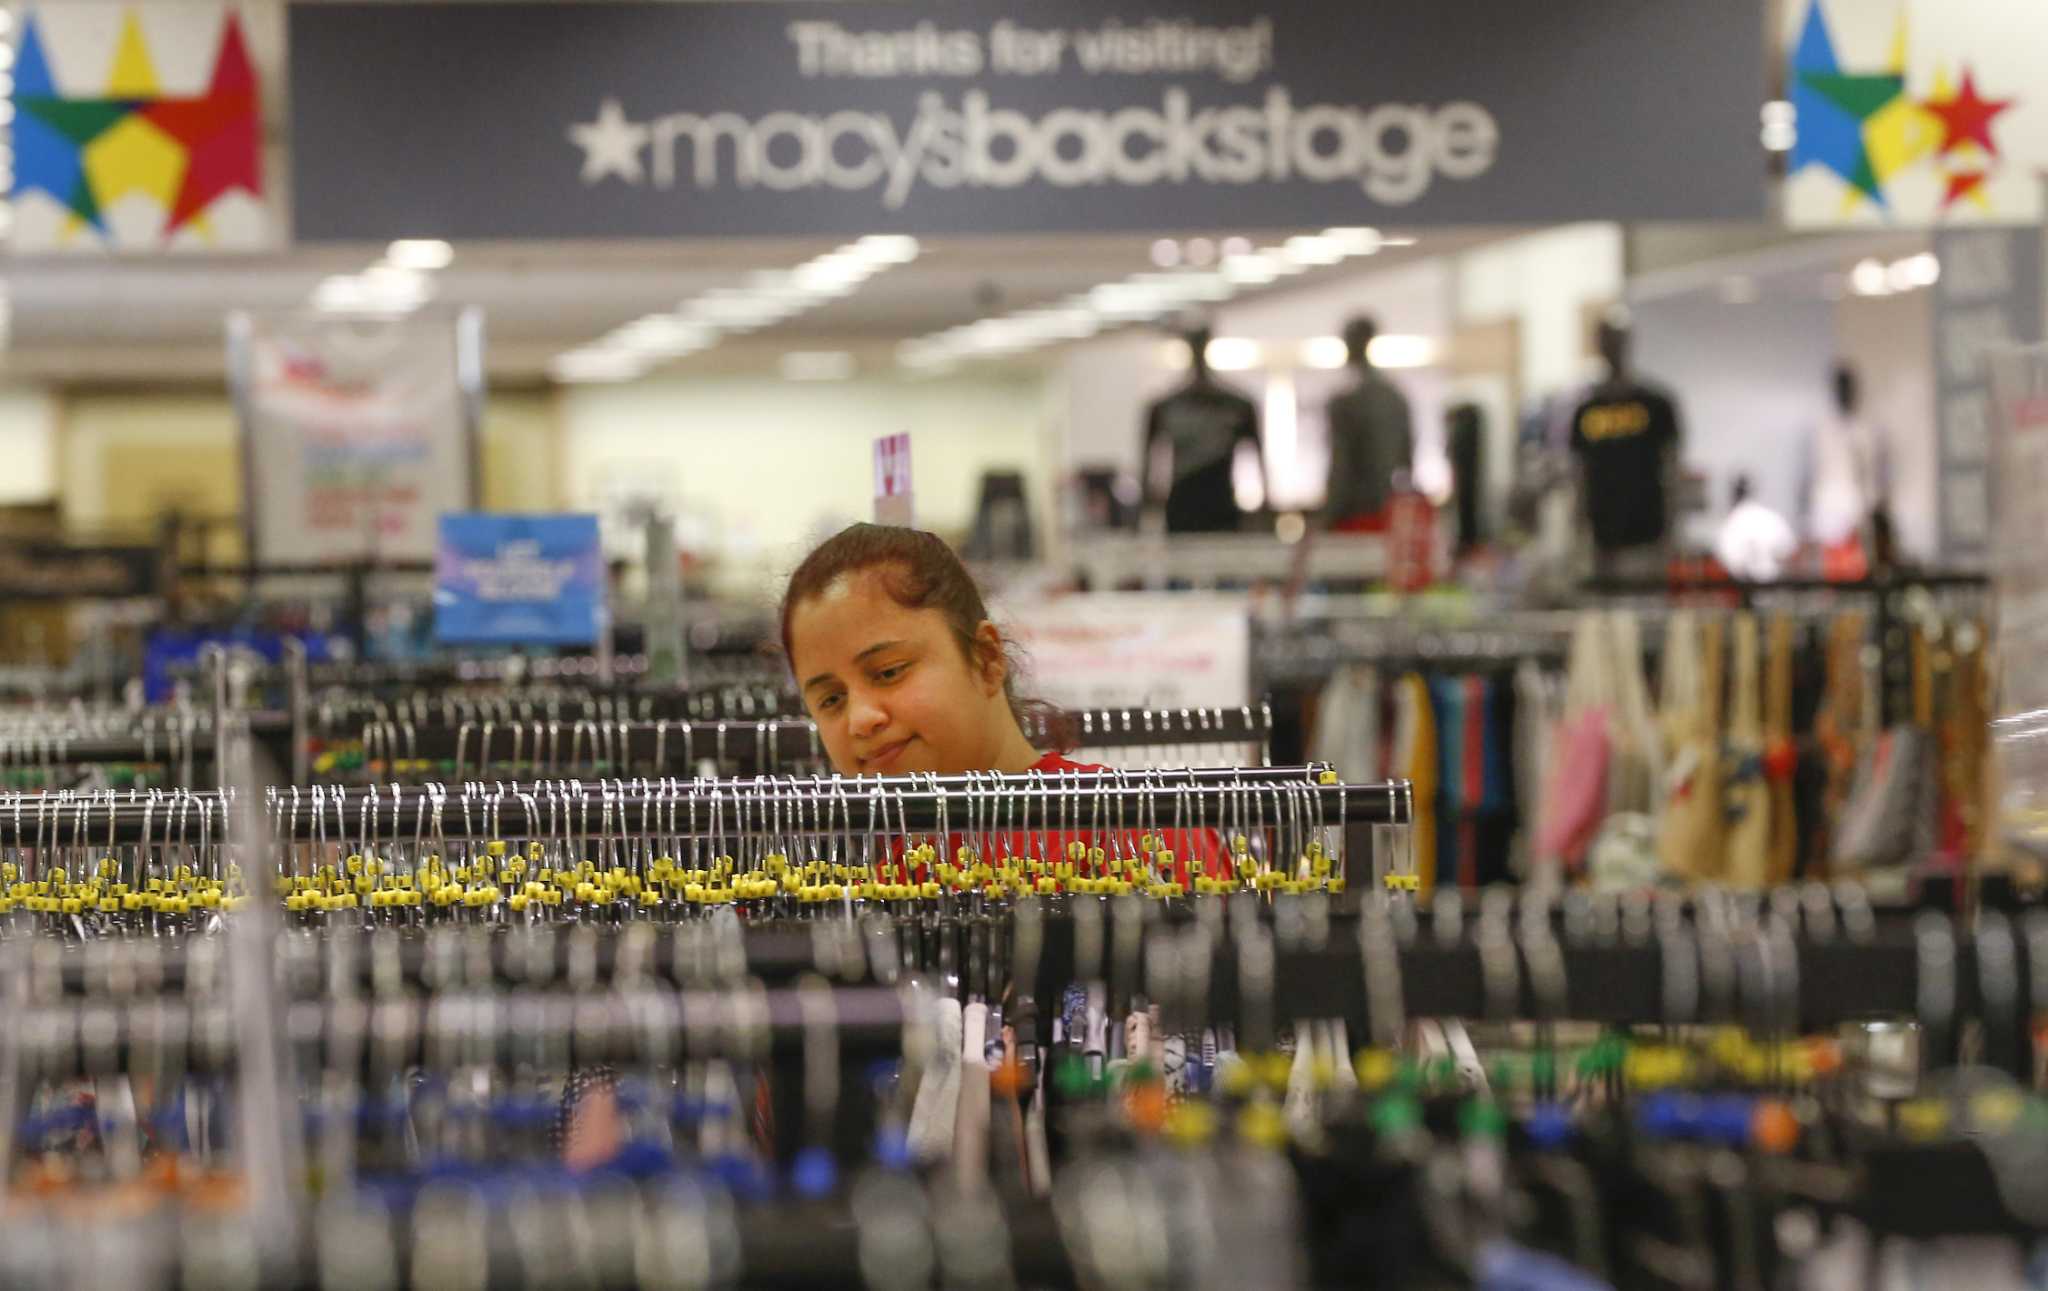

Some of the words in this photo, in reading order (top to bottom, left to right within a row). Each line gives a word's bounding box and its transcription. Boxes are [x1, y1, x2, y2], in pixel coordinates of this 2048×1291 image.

[789, 20, 982, 76] Thanks
[991, 19, 1063, 74] for
[1075, 17, 1271, 81] visiting!
